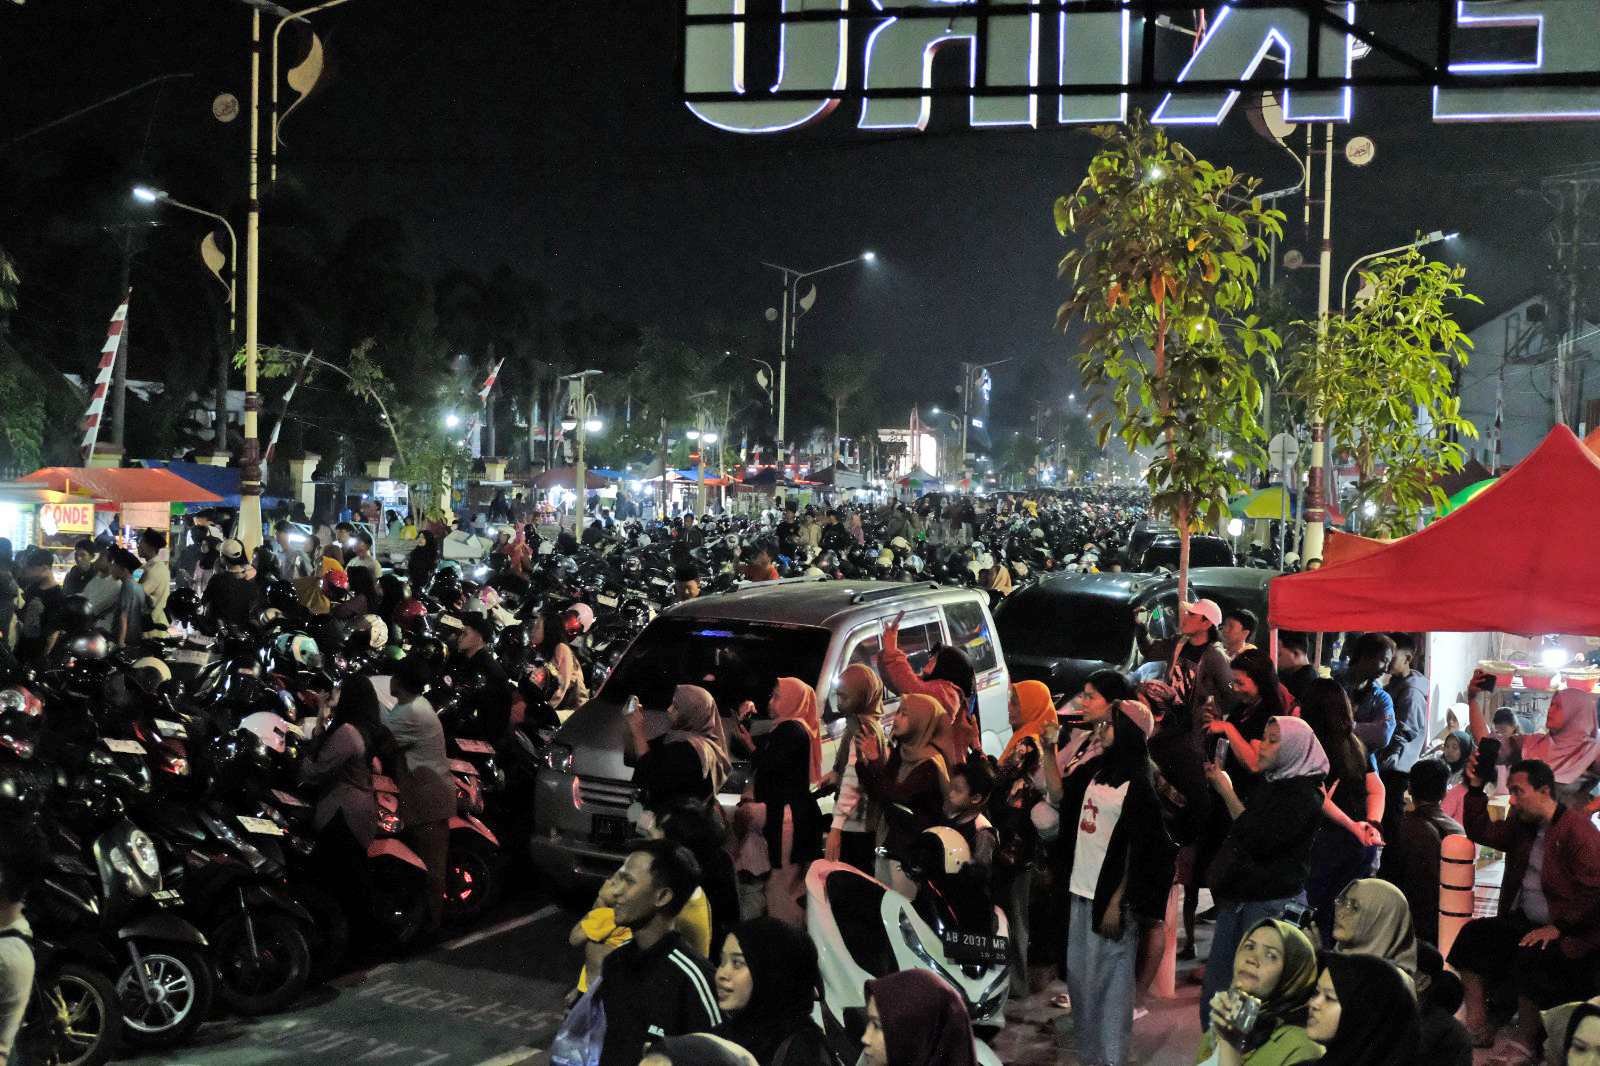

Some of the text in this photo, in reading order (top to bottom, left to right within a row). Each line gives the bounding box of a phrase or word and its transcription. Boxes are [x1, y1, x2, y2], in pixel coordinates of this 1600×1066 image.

[945, 931, 1006, 950] AB 2037 MR
